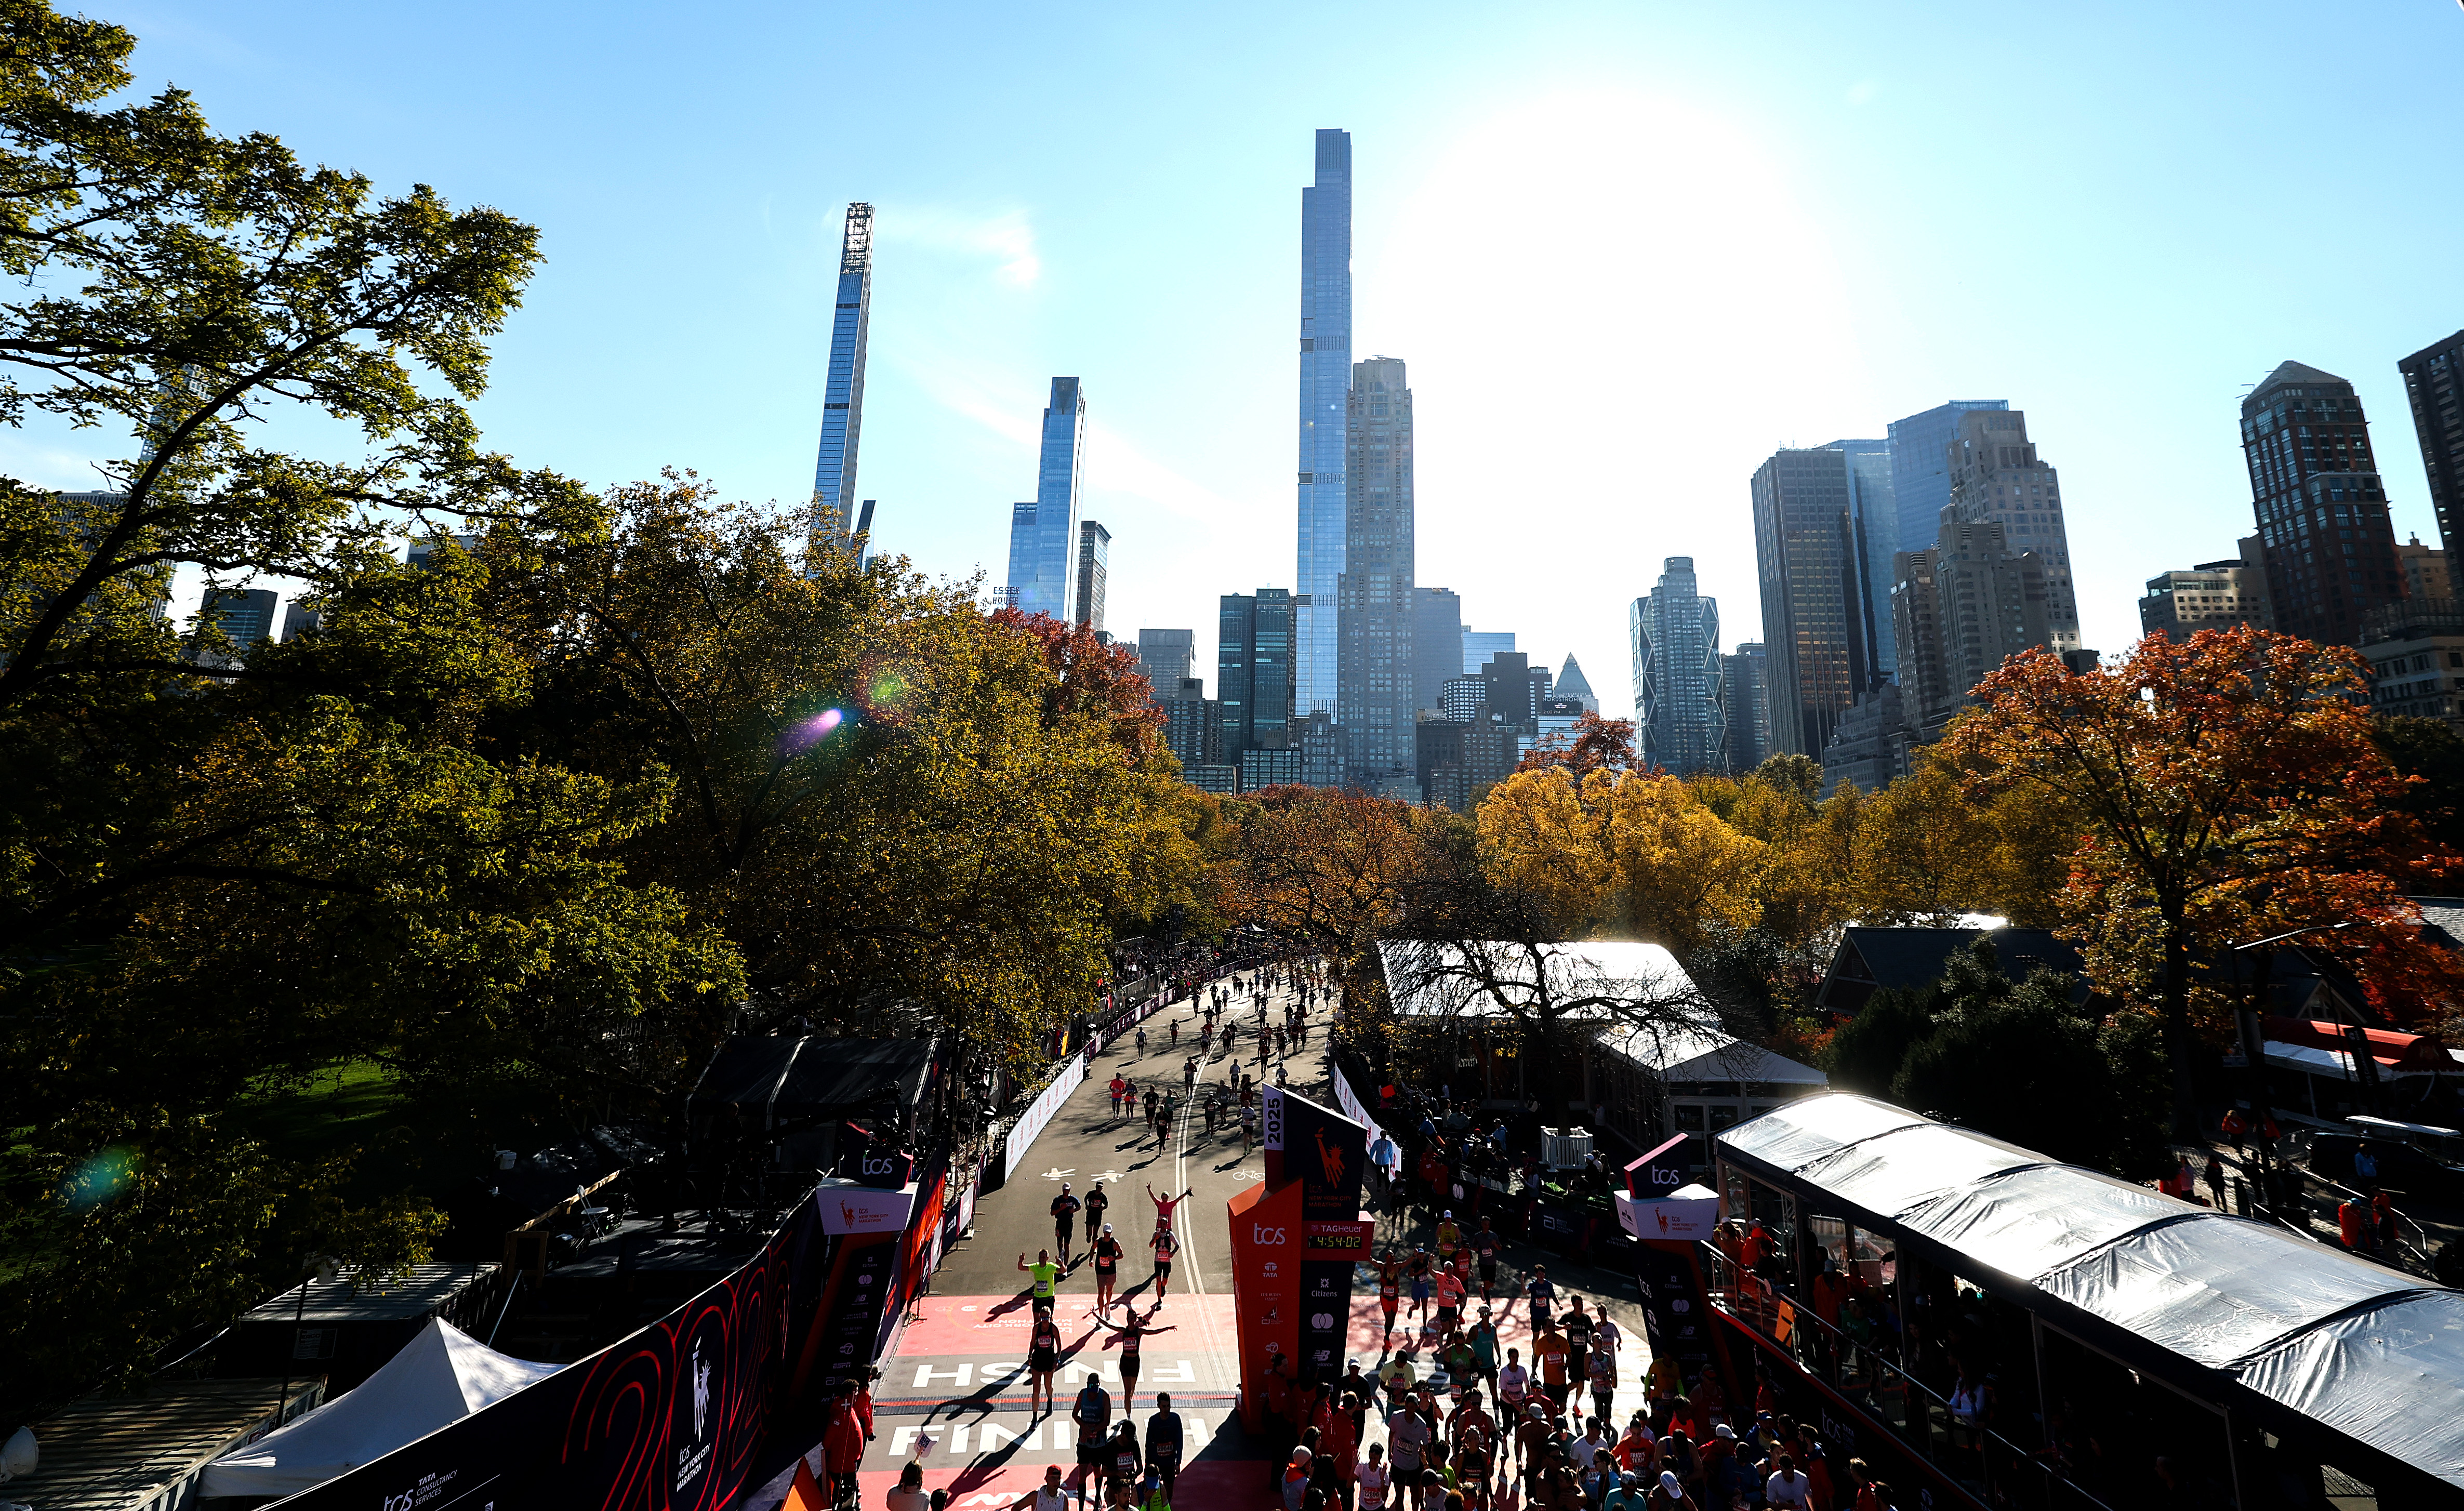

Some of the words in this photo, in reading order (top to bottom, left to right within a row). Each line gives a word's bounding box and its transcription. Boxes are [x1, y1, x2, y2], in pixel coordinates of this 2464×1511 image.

[1268, 1098, 1280, 1144] 2025
[863, 1158, 893, 1175] tcs
[1652, 1165, 1679, 1185] tcs
[1254, 1223, 1286, 1245] tcs
[1606, 1239, 1630, 1249] AIRLINE
[1611, 1236, 1628, 1244] UNITE
[678, 1463, 689, 1480] NEW
[689, 1452, 701, 1469] YORK
[700, 1442, 711, 1459] CITY
[417, 1469, 458, 1496] CONSULTANCY
[419, 1472, 436, 1487] TATA
[677, 1461, 702, 1493] MARATHON
[415, 1486, 442, 1507] SERVICES
